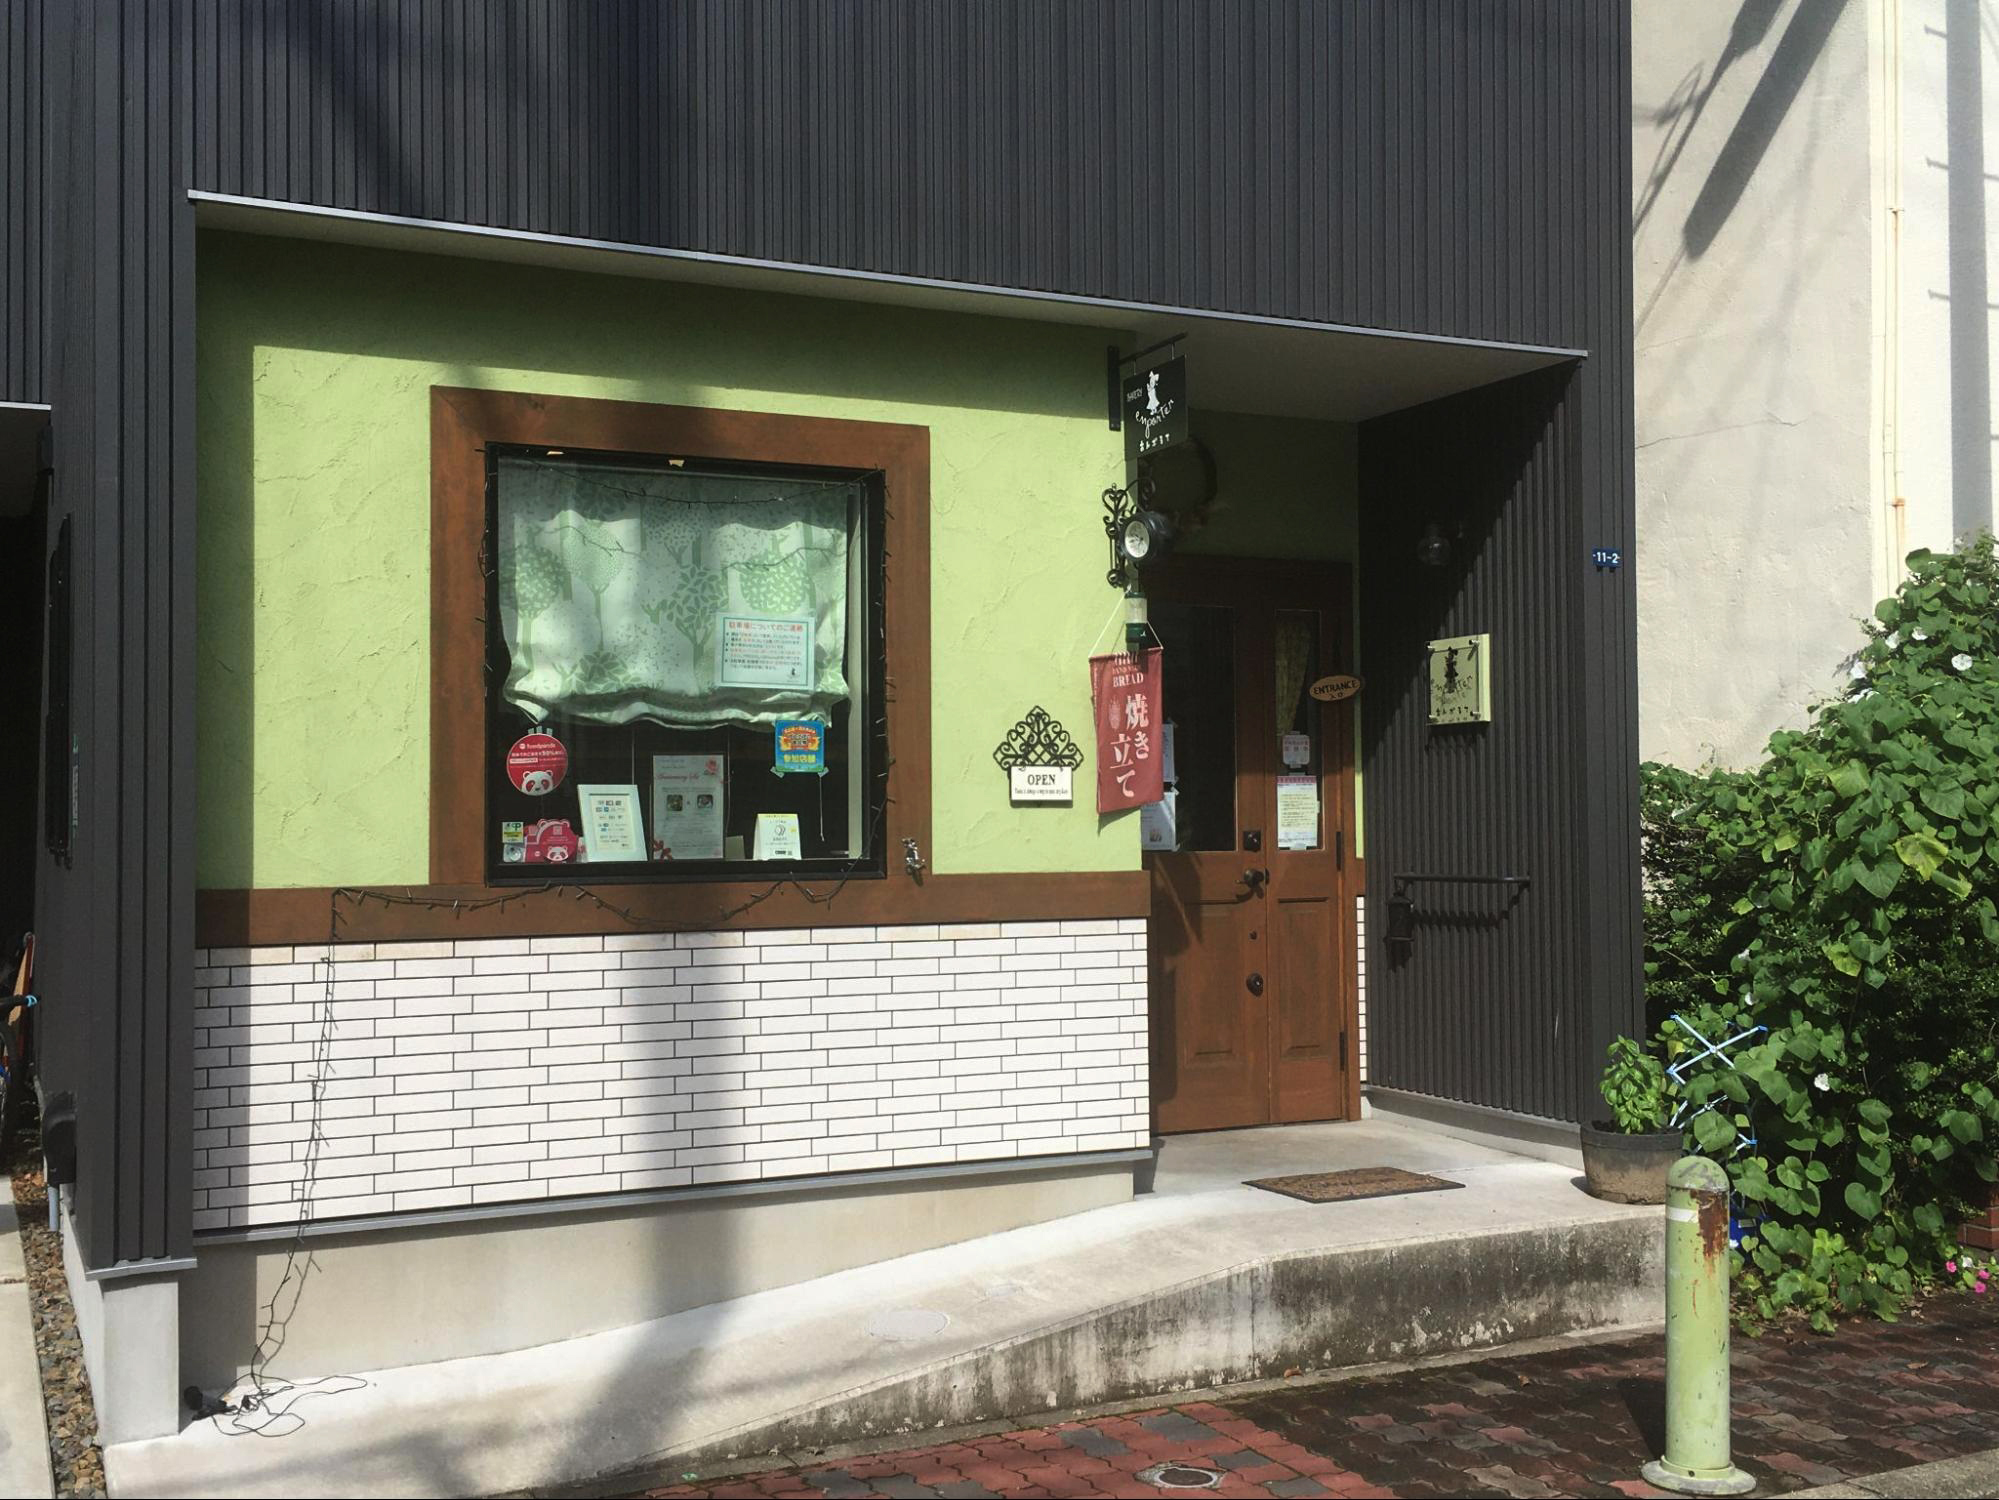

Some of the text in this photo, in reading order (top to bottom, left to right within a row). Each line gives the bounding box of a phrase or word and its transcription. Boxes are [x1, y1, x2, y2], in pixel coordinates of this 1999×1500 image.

[1596, 551, 1619, 564] 11-2
[1112, 672, 1144, 688] BREAD
[1313, 679, 1358, 695] ENTRANCE
[1027, 774, 1056, 786] OPEN
